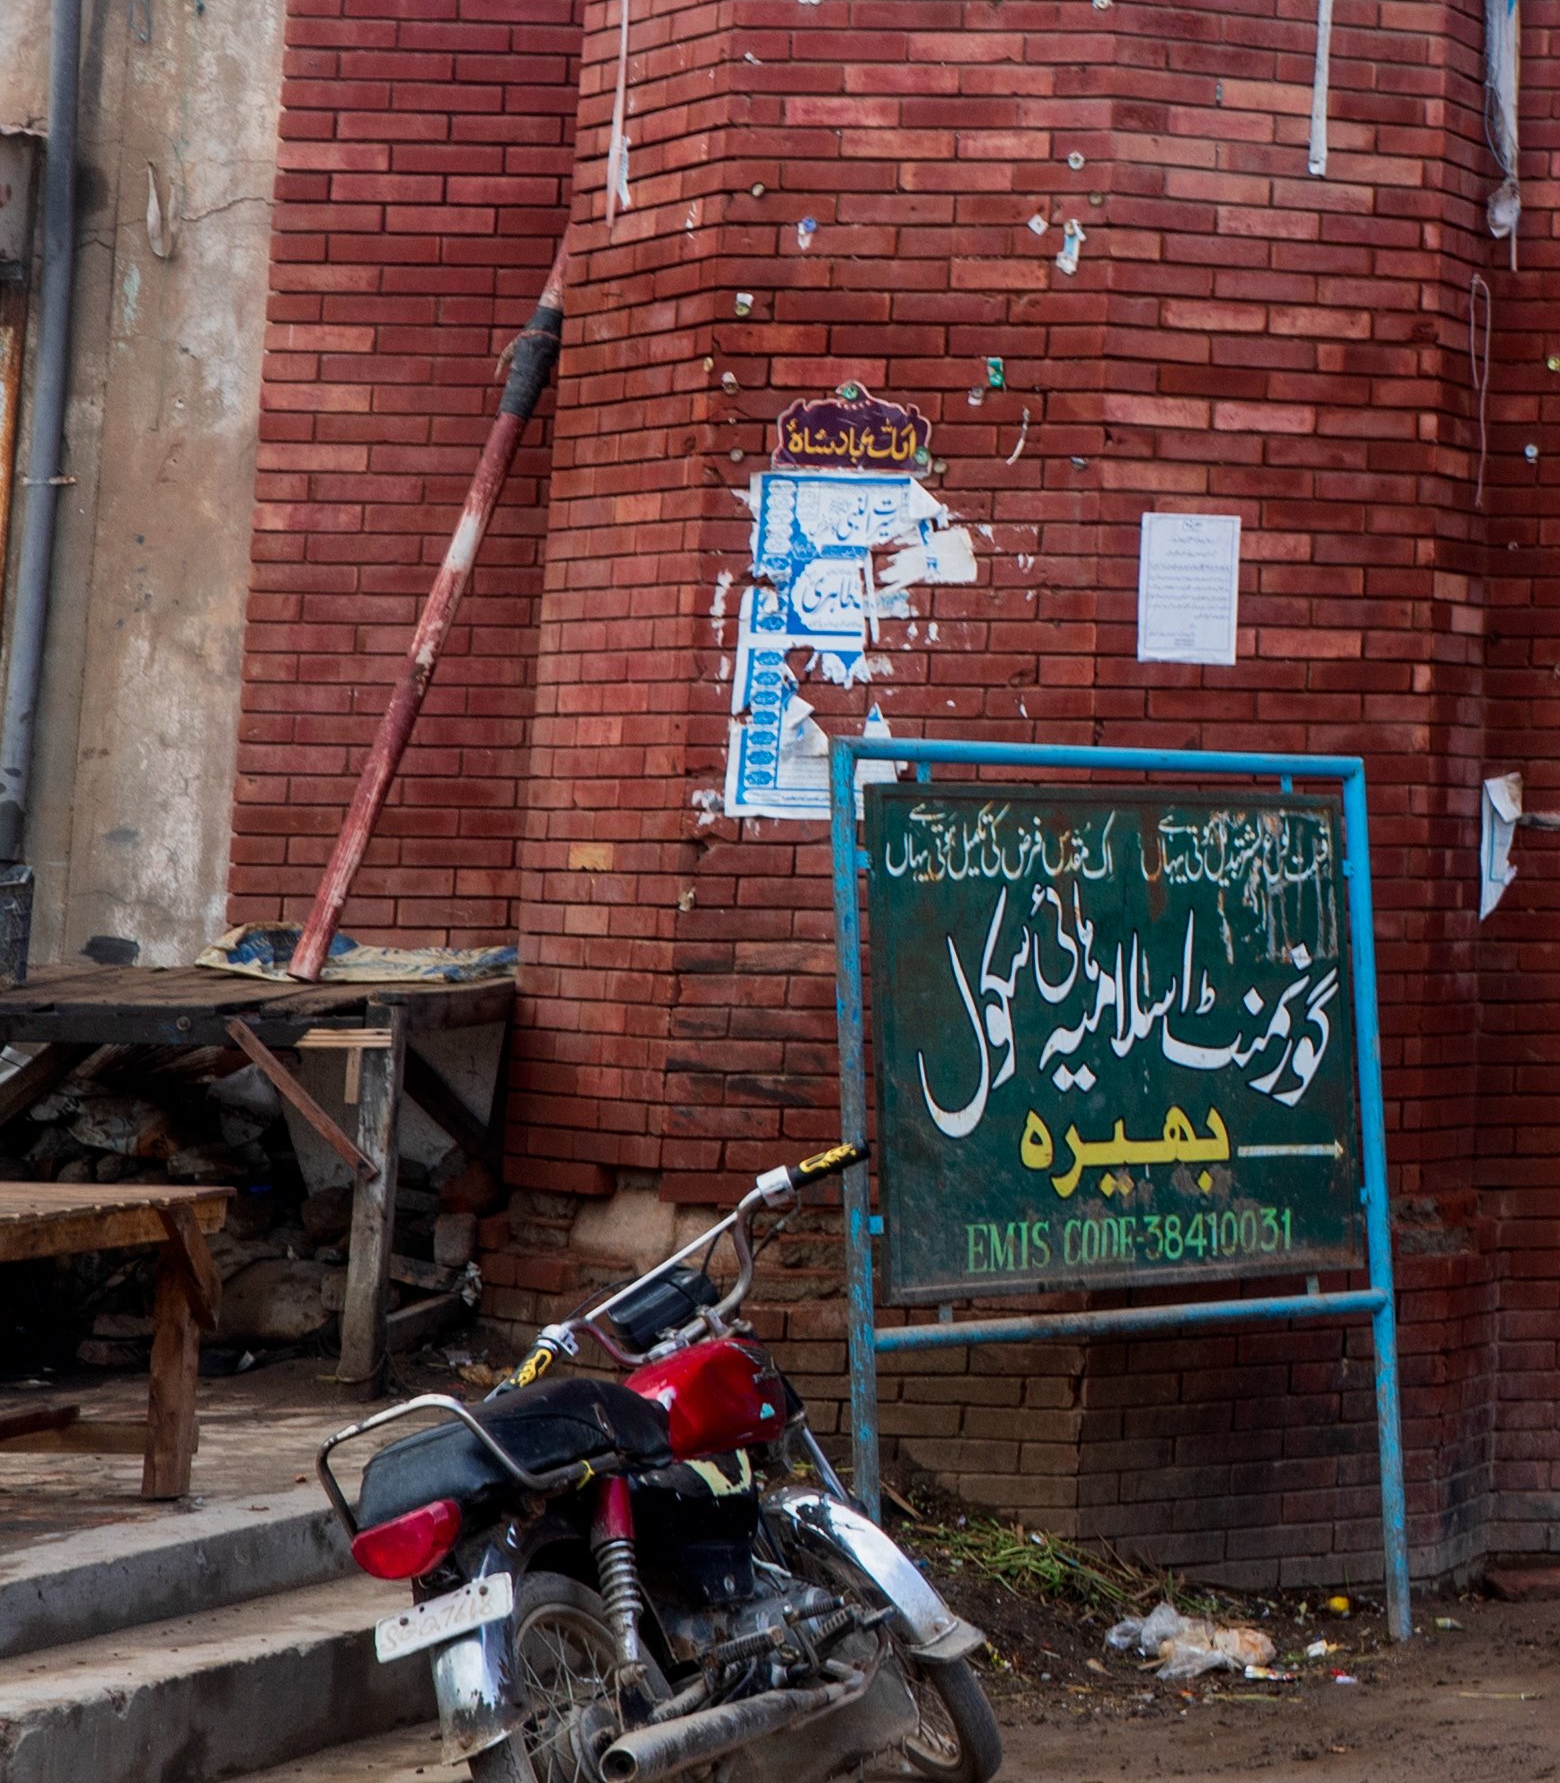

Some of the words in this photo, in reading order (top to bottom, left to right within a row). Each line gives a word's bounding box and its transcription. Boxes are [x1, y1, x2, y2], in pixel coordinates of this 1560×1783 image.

[917, 885, 1031, 1140] سکول
[1038, 907, 1196, 1094] اسلامیہ
[1161, 942, 1342, 1108] گورنمنٹ
[964, 1215, 1052, 1275] EMIS
